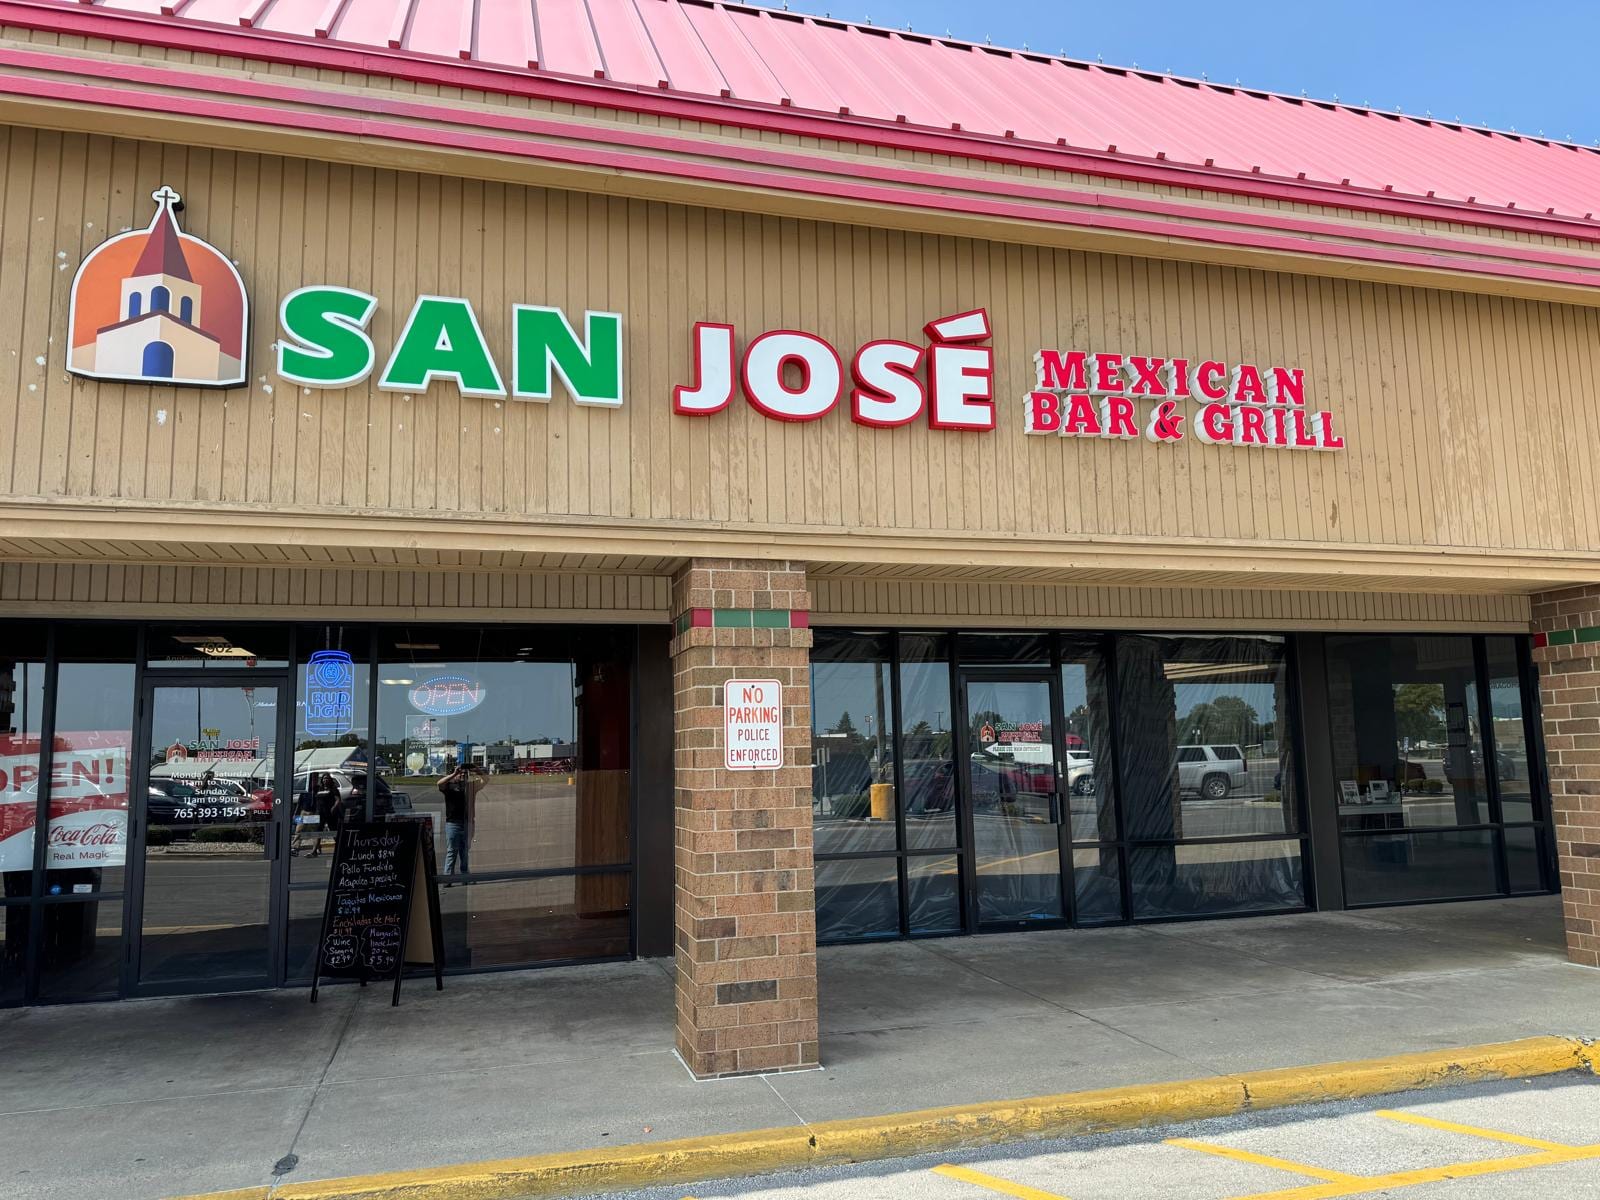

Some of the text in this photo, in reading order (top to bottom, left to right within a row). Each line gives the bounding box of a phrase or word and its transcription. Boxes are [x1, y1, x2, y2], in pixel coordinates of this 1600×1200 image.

[277, 285, 996, 432] SAN JOSÉ
[1033, 349, 1306, 408] MEXICAN
[1023, 390, 1345, 451] BAR & GRILL
[203, 643, 233, 653] 1902
[311, 691, 351, 705] BUD
[413, 682, 480, 707] OPEN
[743, 687, 764, 704] NO
[307, 705, 352, 719] LIGHT
[729, 706, 778, 724] PARKING
[738, 728, 770, 741] POLICE
[189, 736, 260, 750] SAN JOSÉ
[730, 748, 778, 762] ENFORCED
[171, 772, 207, 780] Monday
[214, 770, 253, 779] Saturday
[195, 788, 228, 796] Sunday
[183, 796, 206, 804] 11am
[219, 796, 239, 804] 9pm
[344, 829, 401, 849] Thursday
[53, 851, 110, 861] Real Magic
[348, 849, 375, 861] Lunch
[339, 859, 394, 875] Pollo Fundido
